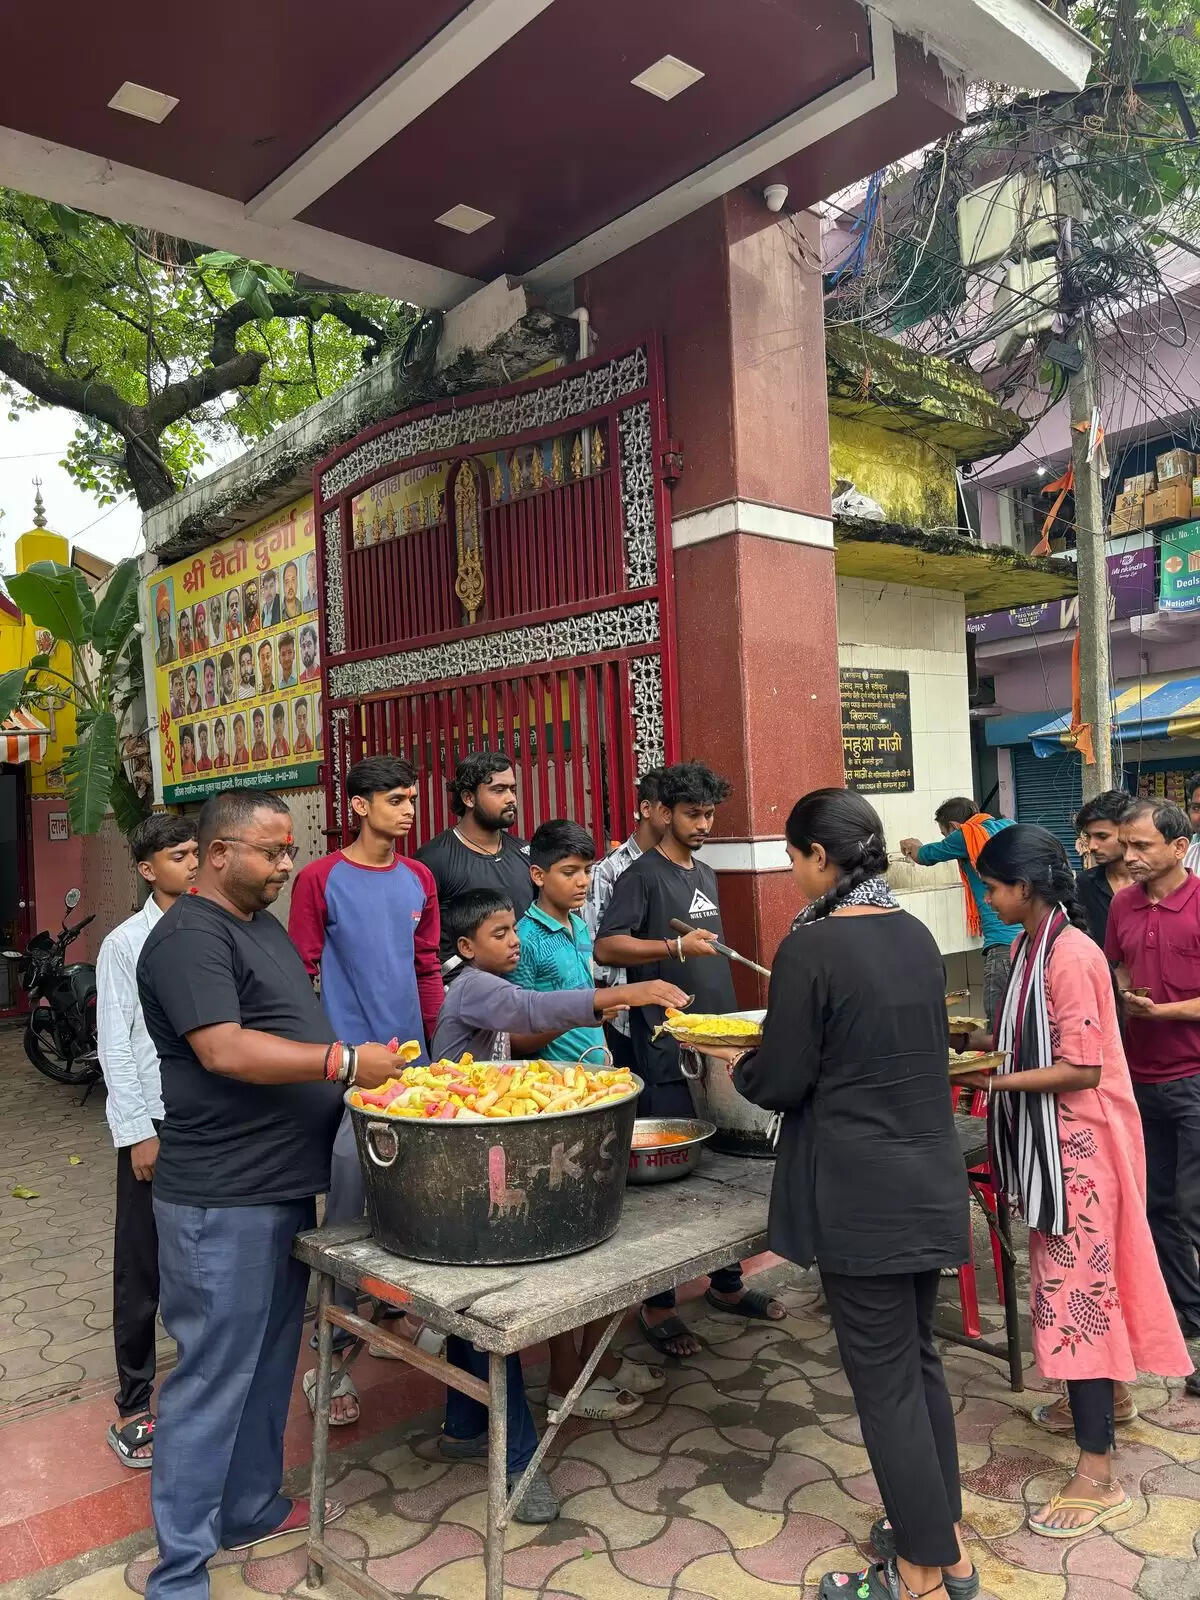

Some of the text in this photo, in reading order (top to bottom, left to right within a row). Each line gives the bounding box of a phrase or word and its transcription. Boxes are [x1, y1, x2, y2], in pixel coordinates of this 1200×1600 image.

[1178, 530, 1189, 539] No.
[182, 556, 207, 594] श्री
[209, 537, 249, 582] चैती
[253, 507, 298, 571] दुर्गा
[1176, 577, 1200, 588] Deals
[1165, 596, 1195, 607] National
[966, 623, 986, 633] News
[843, 737, 874, 758] महुआ
[51, 819, 67, 834] लाभ
